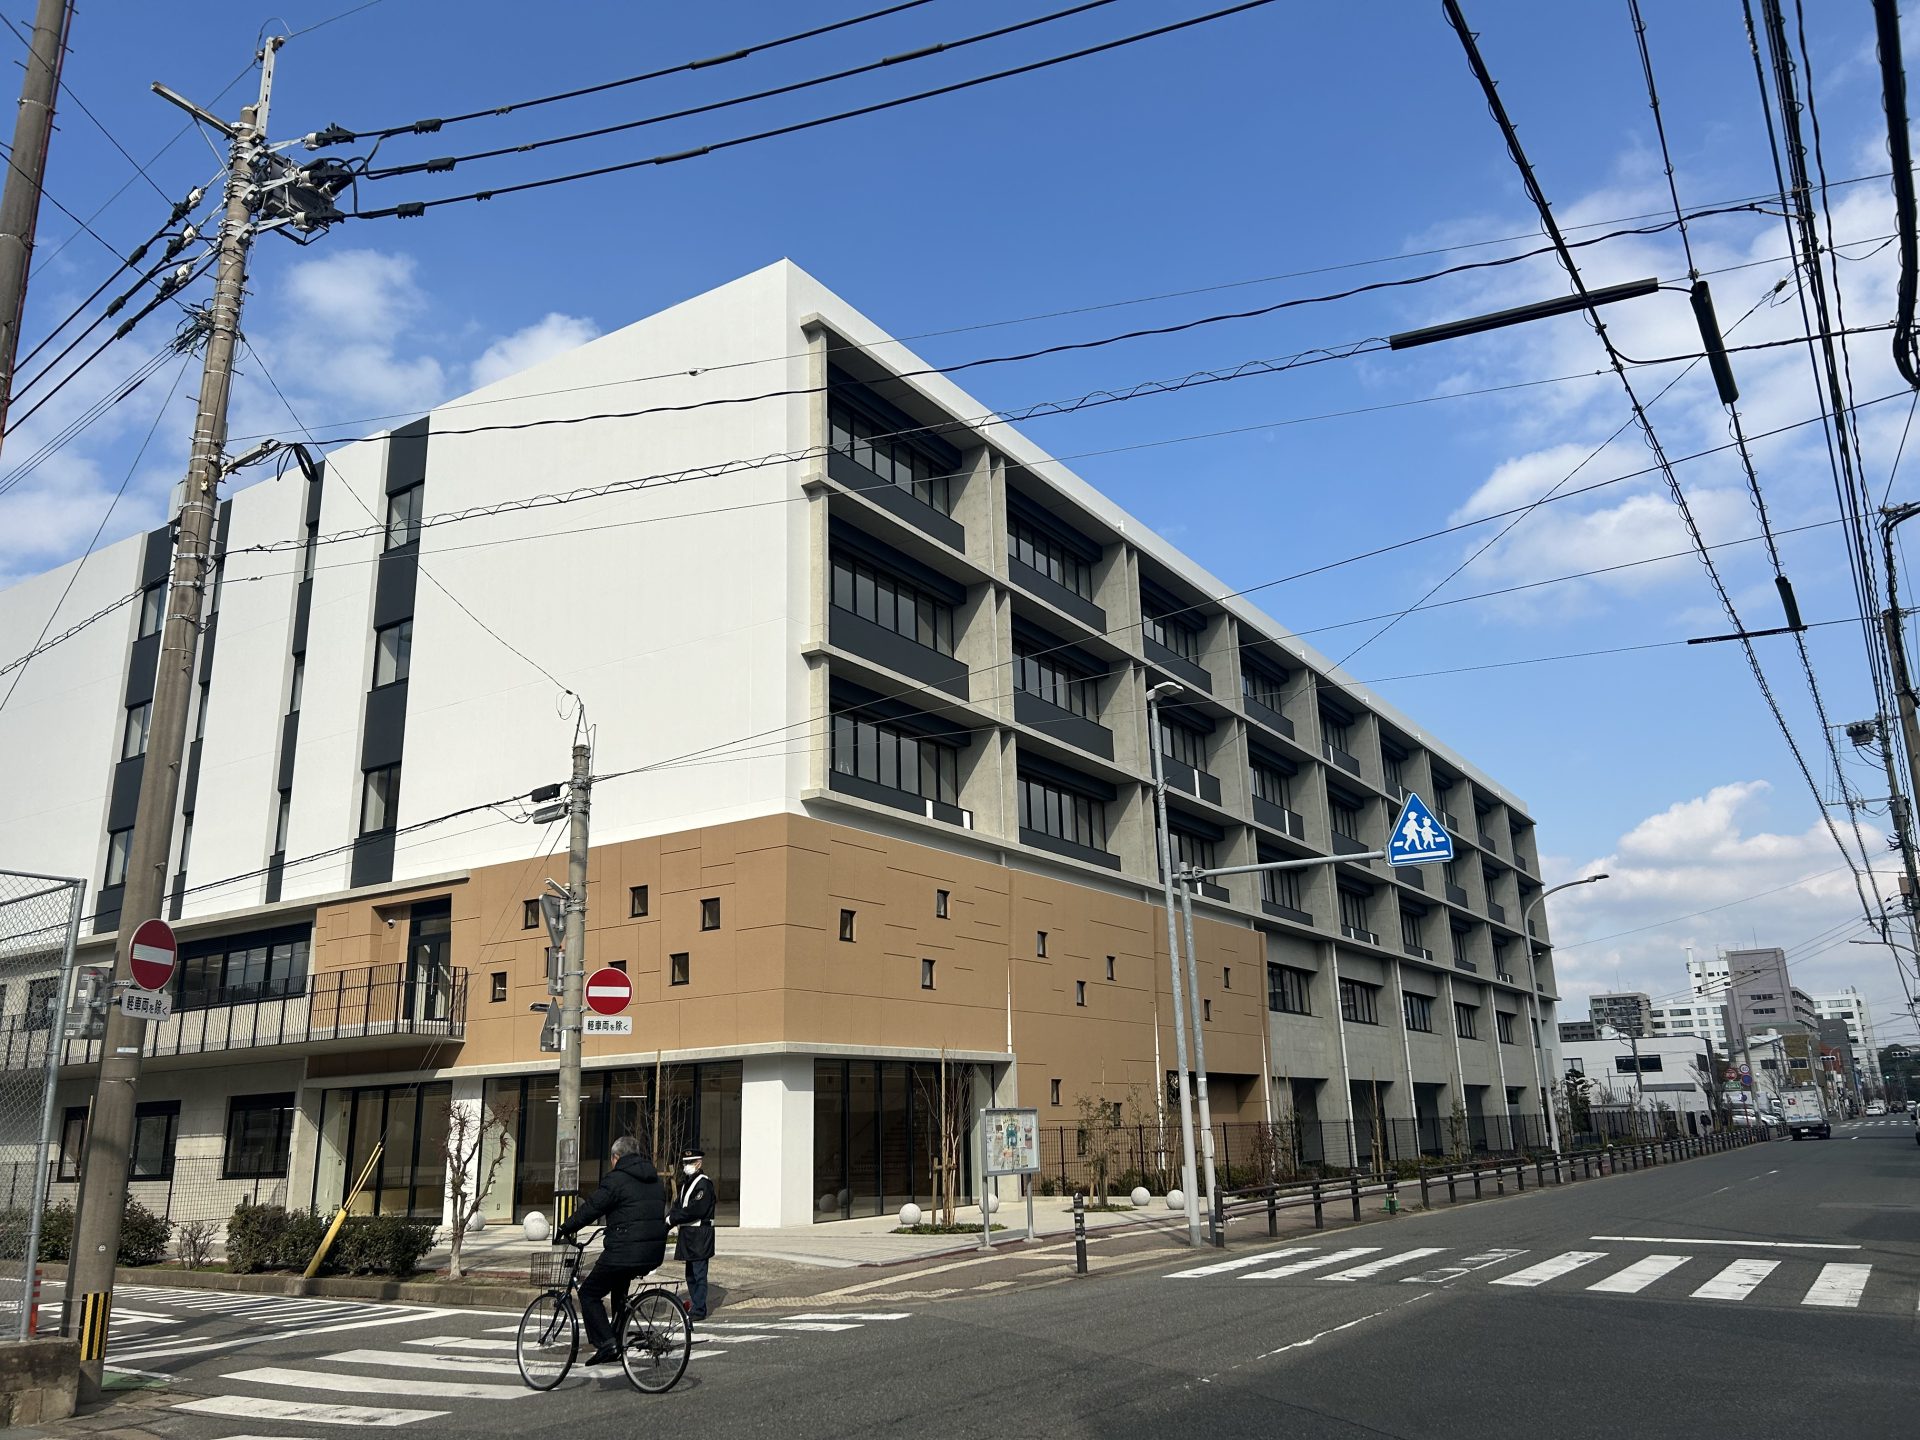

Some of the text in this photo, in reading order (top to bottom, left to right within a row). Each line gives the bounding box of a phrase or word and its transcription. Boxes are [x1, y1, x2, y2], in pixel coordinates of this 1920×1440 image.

[126, 995, 168, 1016] 軽車両を除く
[587, 1020, 629, 1031] 軽車両を除く
